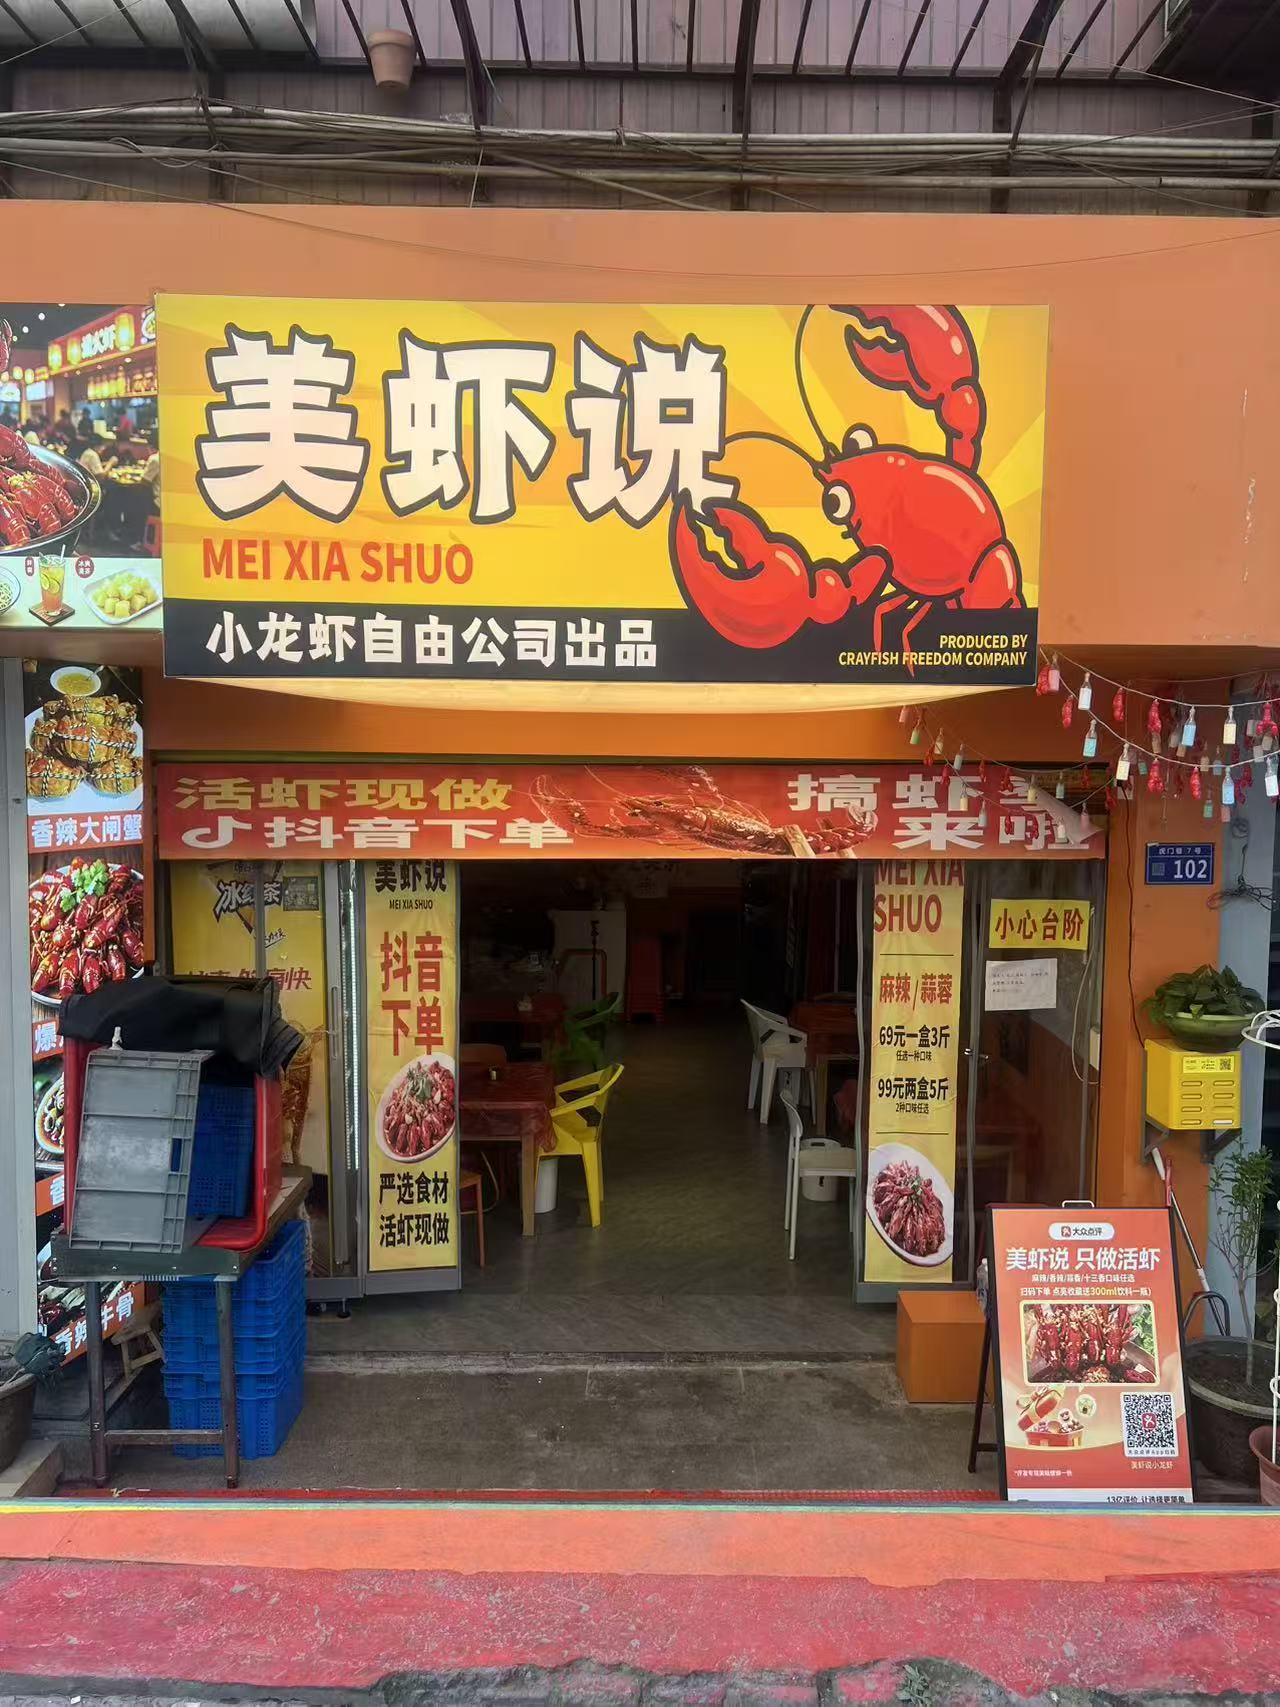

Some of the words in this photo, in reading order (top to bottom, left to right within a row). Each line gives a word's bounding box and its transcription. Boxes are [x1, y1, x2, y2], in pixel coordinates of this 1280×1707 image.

[195, 322, 740, 530] 美虾说
[202, 538, 272, 580] MEI
[283, 540, 350, 583] XIA
[361, 543, 474, 585] SHUO
[206, 611, 657, 669] 小龙虾自由公司出品
[939, 635, 1009, 649] PRODUCED
[1011, 634, 1028, 648] BY
[838, 651, 899, 666] CRAYFISH
[902, 652, 962, 666] FREEDOM
[965, 652, 1027, 666] COMPANY
[173, 777, 513, 812] 活虾现做
[31, 813, 143, 849] 香辣大闸蟹
[264, 815, 574, 850] 抖音下单
[892, 812, 1090, 852] 来啦
[375, 860, 447, 893] 美虾说
[874, 860, 916, 886] MEI
[924, 860, 964, 887] XIA
[1173, 859, 1207, 879] 102
[389, 900, 401, 910] MEI
[402, 900, 414, 910] XIA
[414, 900, 433, 910] SHUO
[873, 894, 942, 933] SHUO
[995, 908, 1084, 941] 小心台阶
[380, 931, 443, 992] 抖音
[880, 972, 953, 1010] 麻辣/蒜蓉
[382, 996, 444, 1056] 下单
[880, 1025, 950, 1048] 69元一盒3斤
[896, 1050, 932, 1061] 任选一种口味
[878, 1077, 949, 1100] 99元两盒5斤
[896, 1102, 930, 1114] 2种口味任选
[379, 1171, 449, 1205] 严选食材
[379, 1213, 450, 1248] 活虾现做
[1072, 1227, 1103, 1237] 大众点评
[1006, 1247, 1070, 1271] 美虾说
[1075, 1247, 1161, 1271] 只做活虾
[1020, 1287, 1050, 1297] 扫码下单
